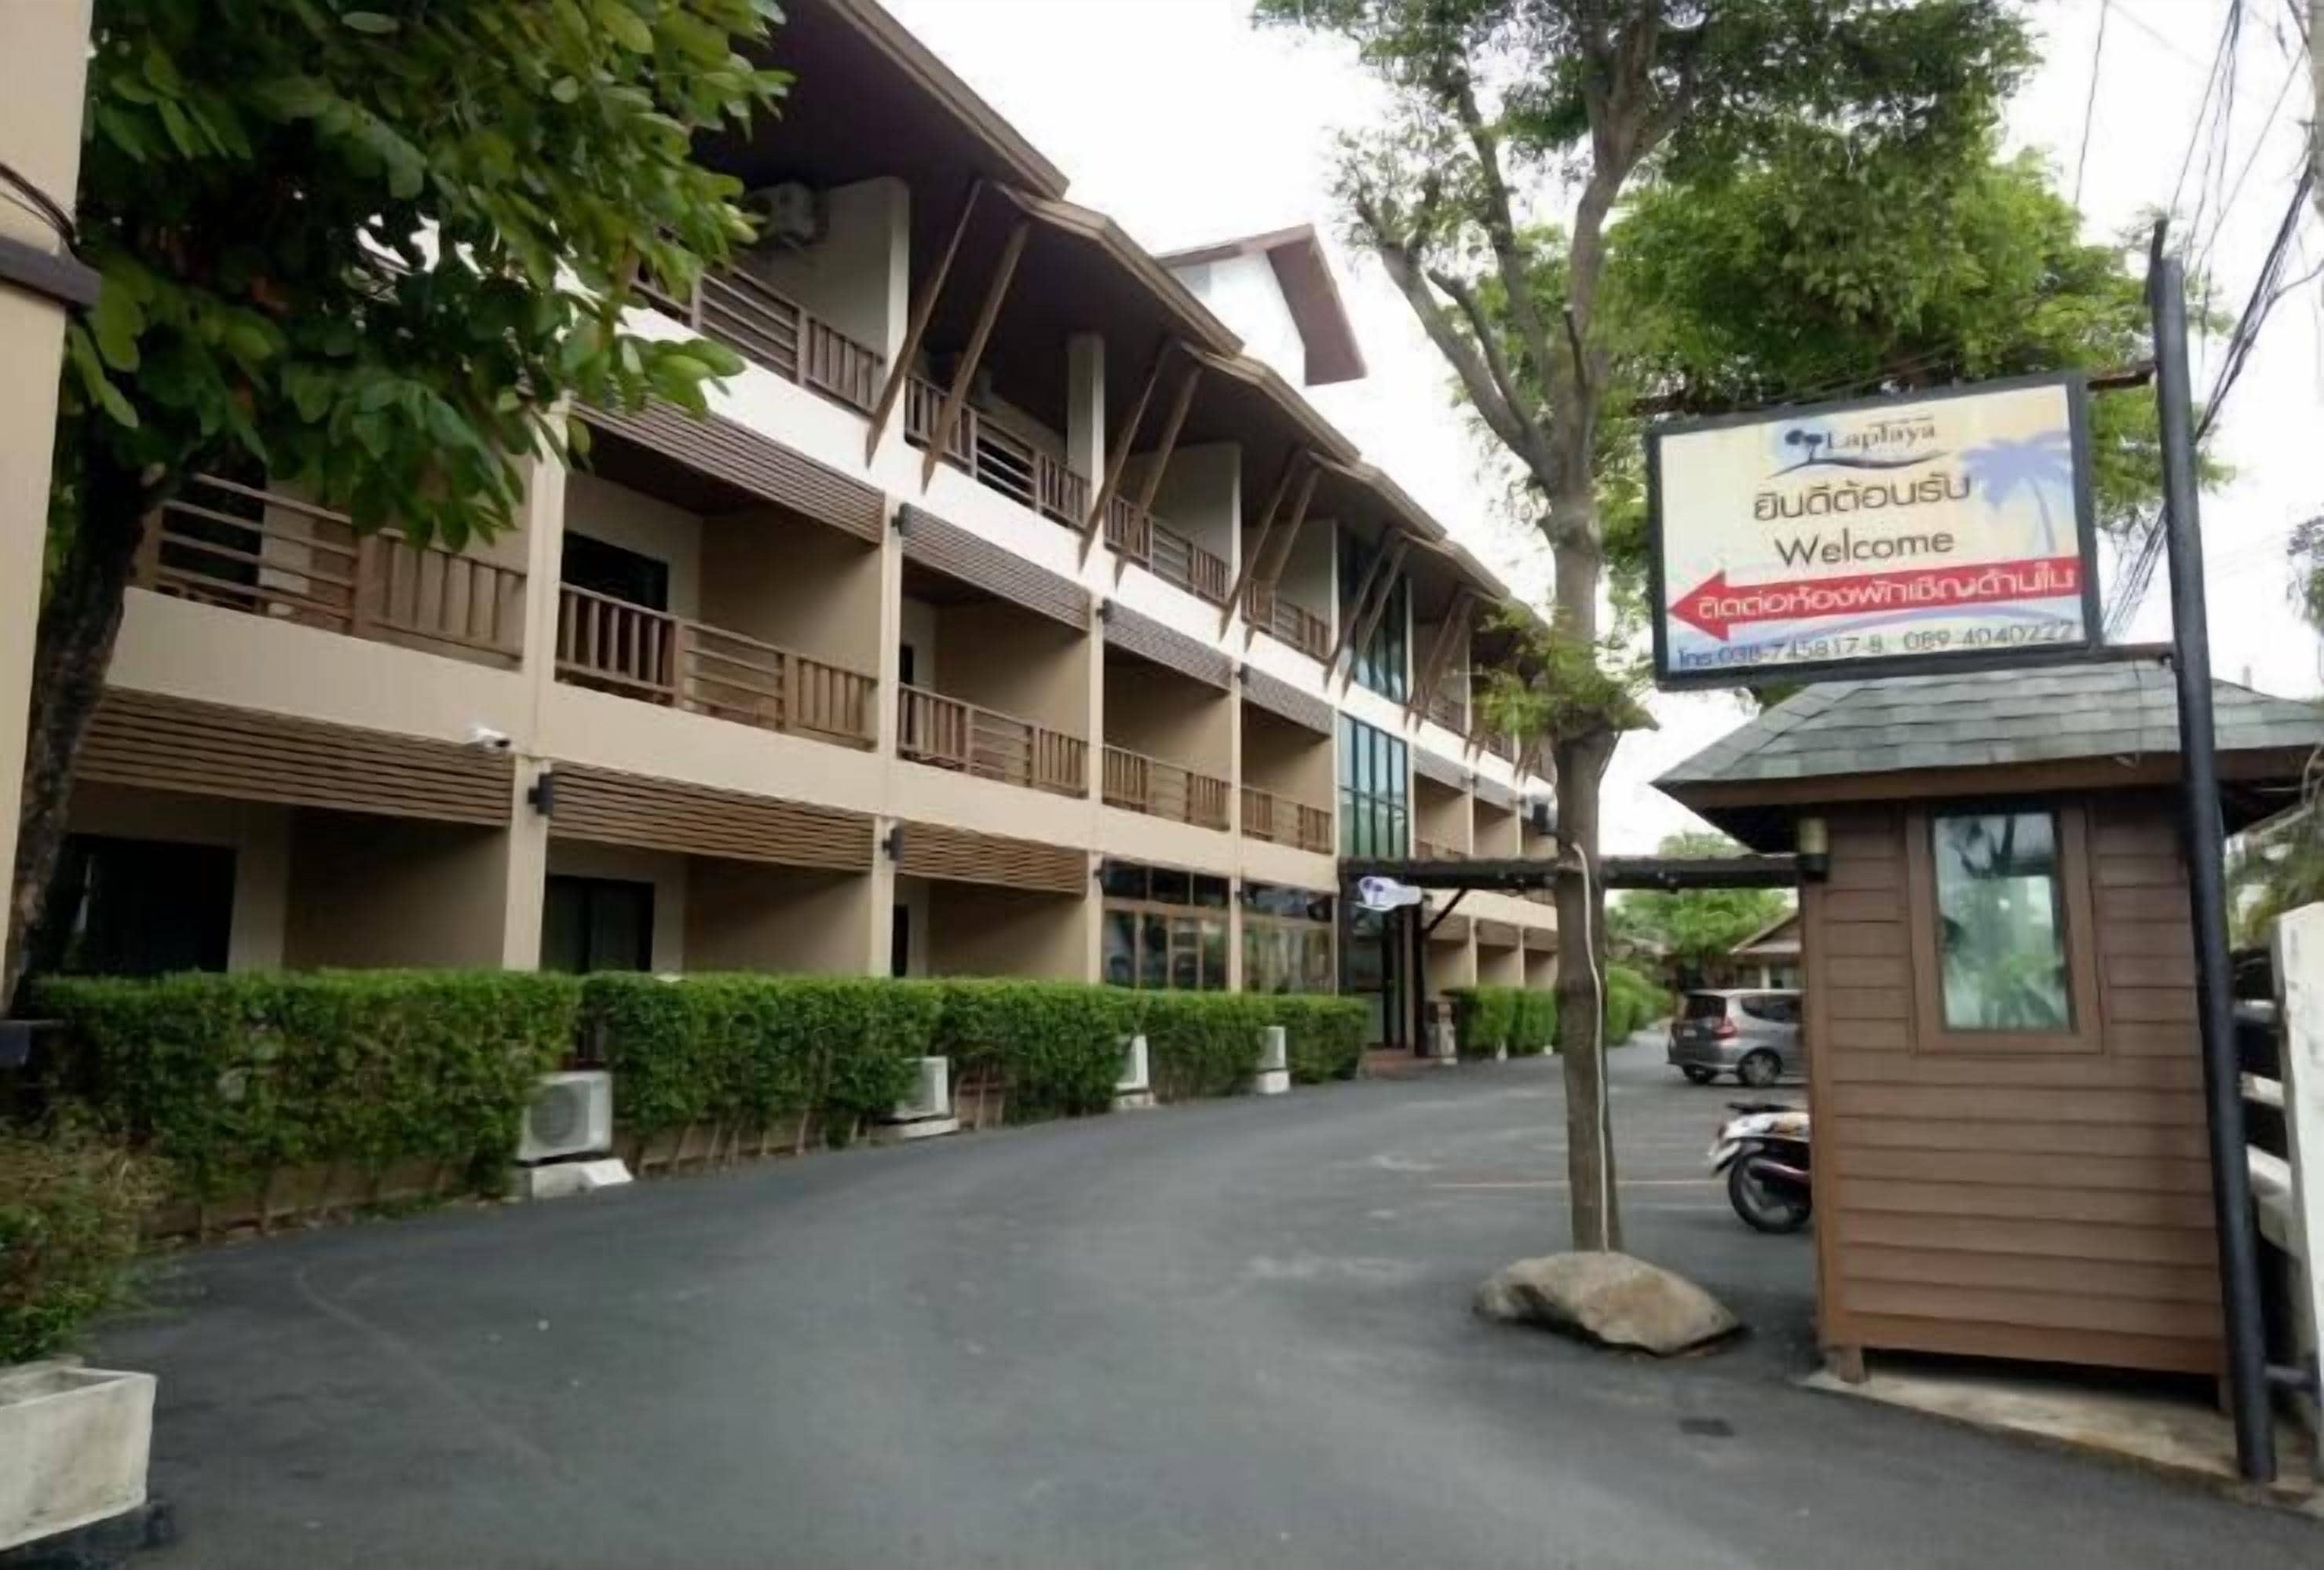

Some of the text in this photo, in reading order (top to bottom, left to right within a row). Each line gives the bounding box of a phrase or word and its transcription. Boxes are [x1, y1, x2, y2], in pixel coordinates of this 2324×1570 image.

[1754, 471, 1970, 521] ยินดีต้อนรับ
[1774, 527, 1954, 568] Welcome
